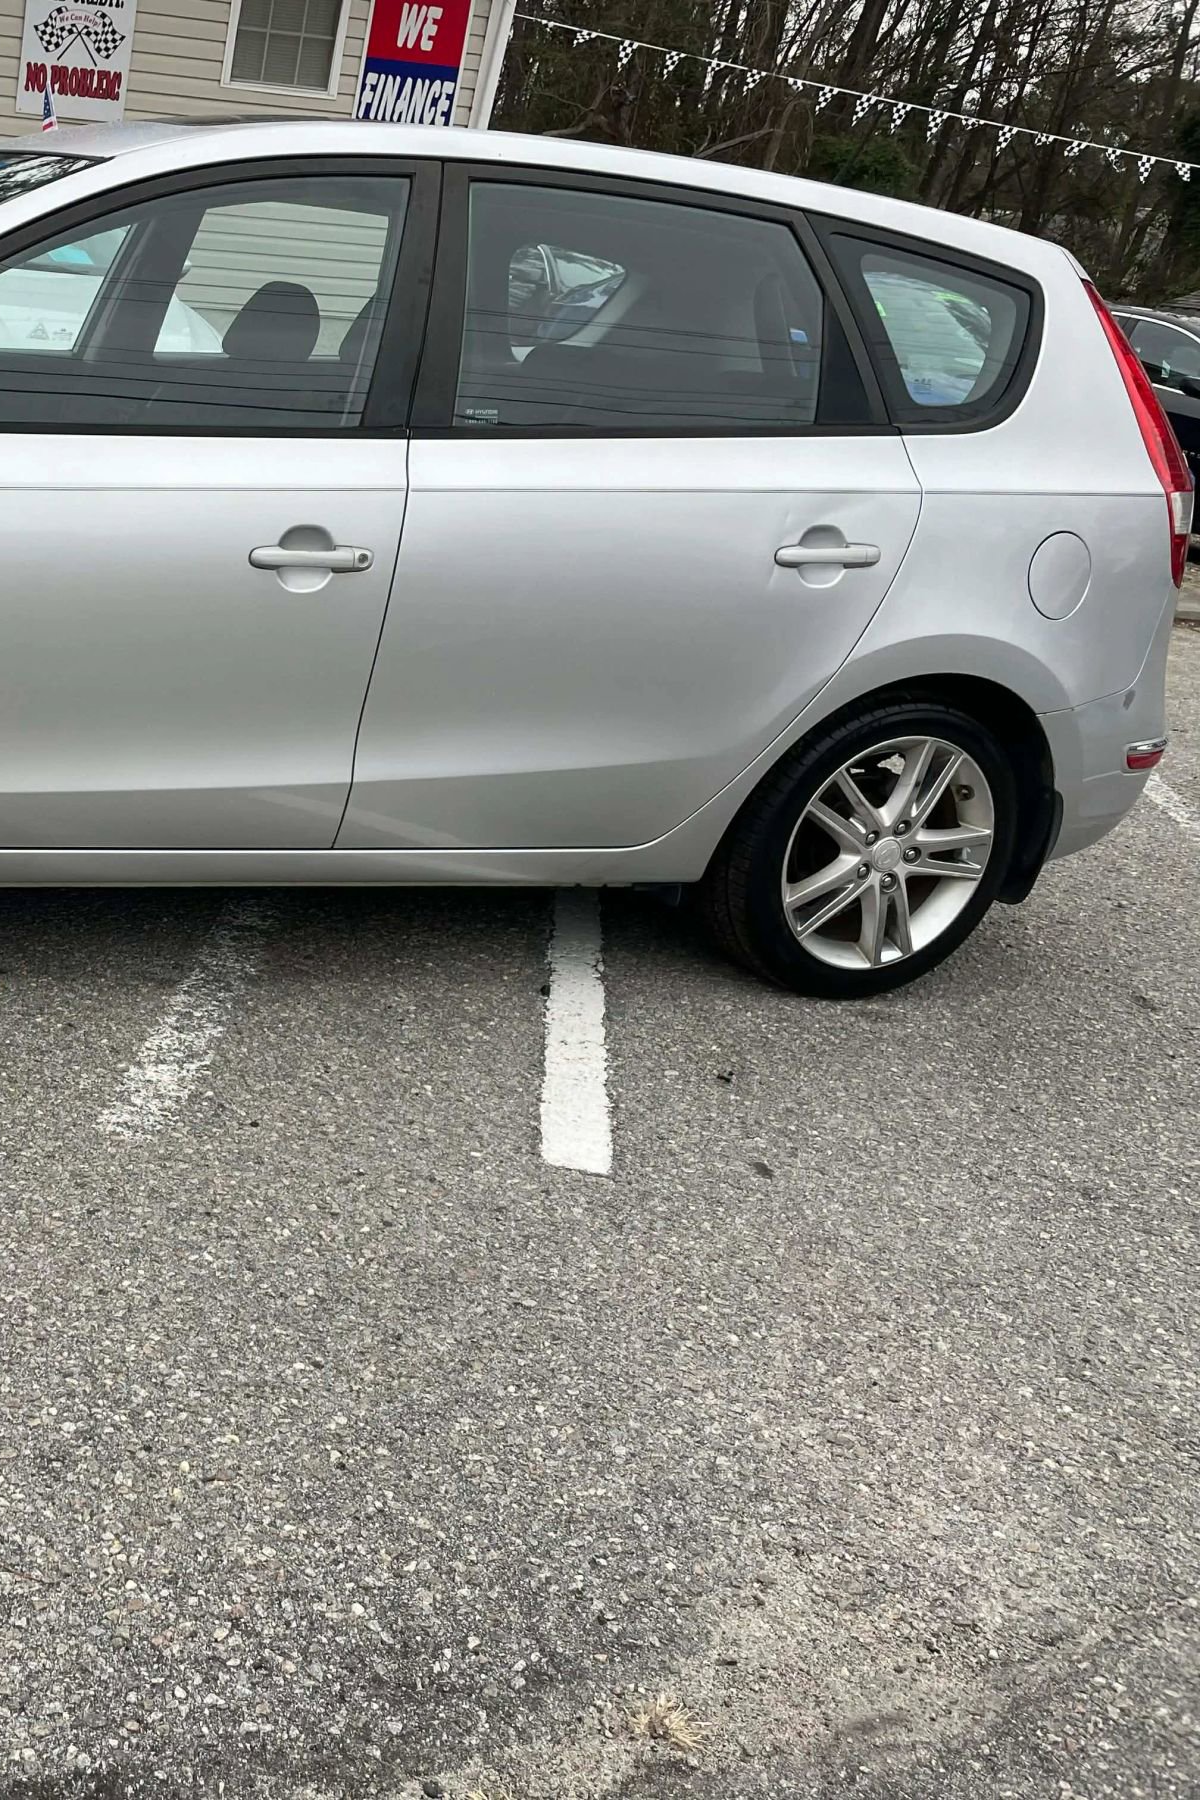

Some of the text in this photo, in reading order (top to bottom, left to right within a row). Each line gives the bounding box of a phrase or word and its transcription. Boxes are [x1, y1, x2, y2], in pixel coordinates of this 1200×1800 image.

[84, 15, 101, 28] Help!
[397, 2, 443, 51] WE
[24, 61, 122, 101] NO PROBLEM!
[358, 72, 455, 126] FINANCE
